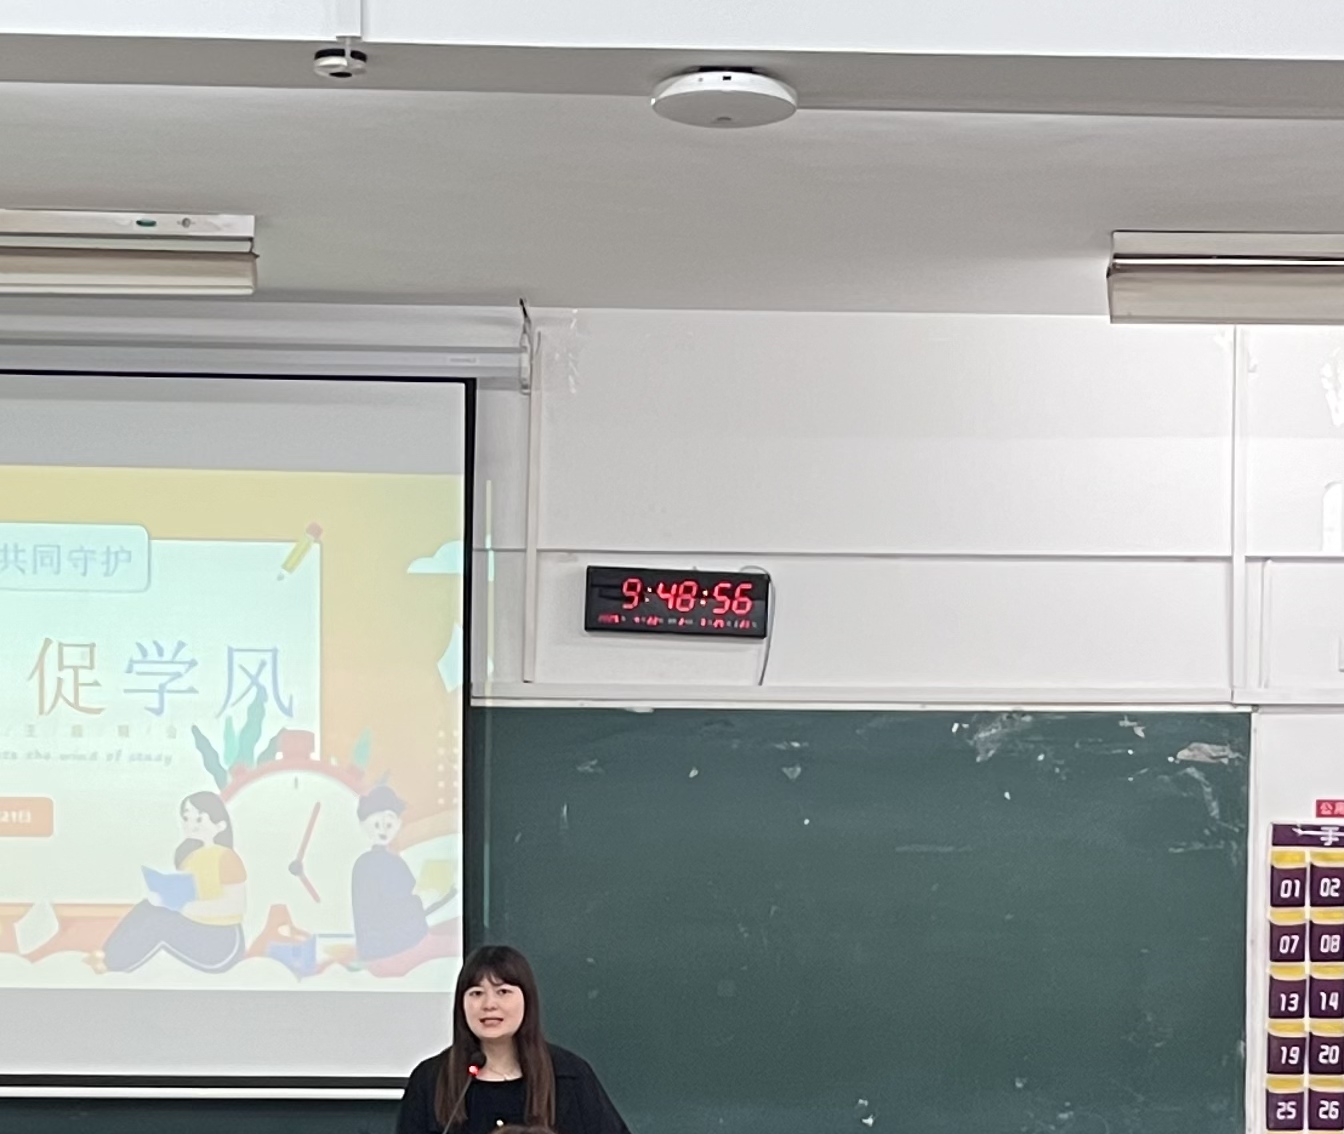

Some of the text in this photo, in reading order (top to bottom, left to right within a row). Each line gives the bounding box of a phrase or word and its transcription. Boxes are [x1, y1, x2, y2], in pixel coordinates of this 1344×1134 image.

[622, 578, 753, 614] 9:48:56
[27, 637, 293, 718] 促学风
[1281, 880, 1300, 898] 01
[1320, 878, 1340, 896] 02
[1280, 935, 1299, 953] 07
[1320, 935, 1340, 952] 08
[1281, 994, 1299, 1011] 13
[1320, 992, 1338, 1010] 14
[1281, 1047, 1299, 1064] 19
[1319, 1045, 1339, 1064] 20
[1277, 1102, 1296, 1119] 25
[1319, 1101, 1339, 1119] 26
